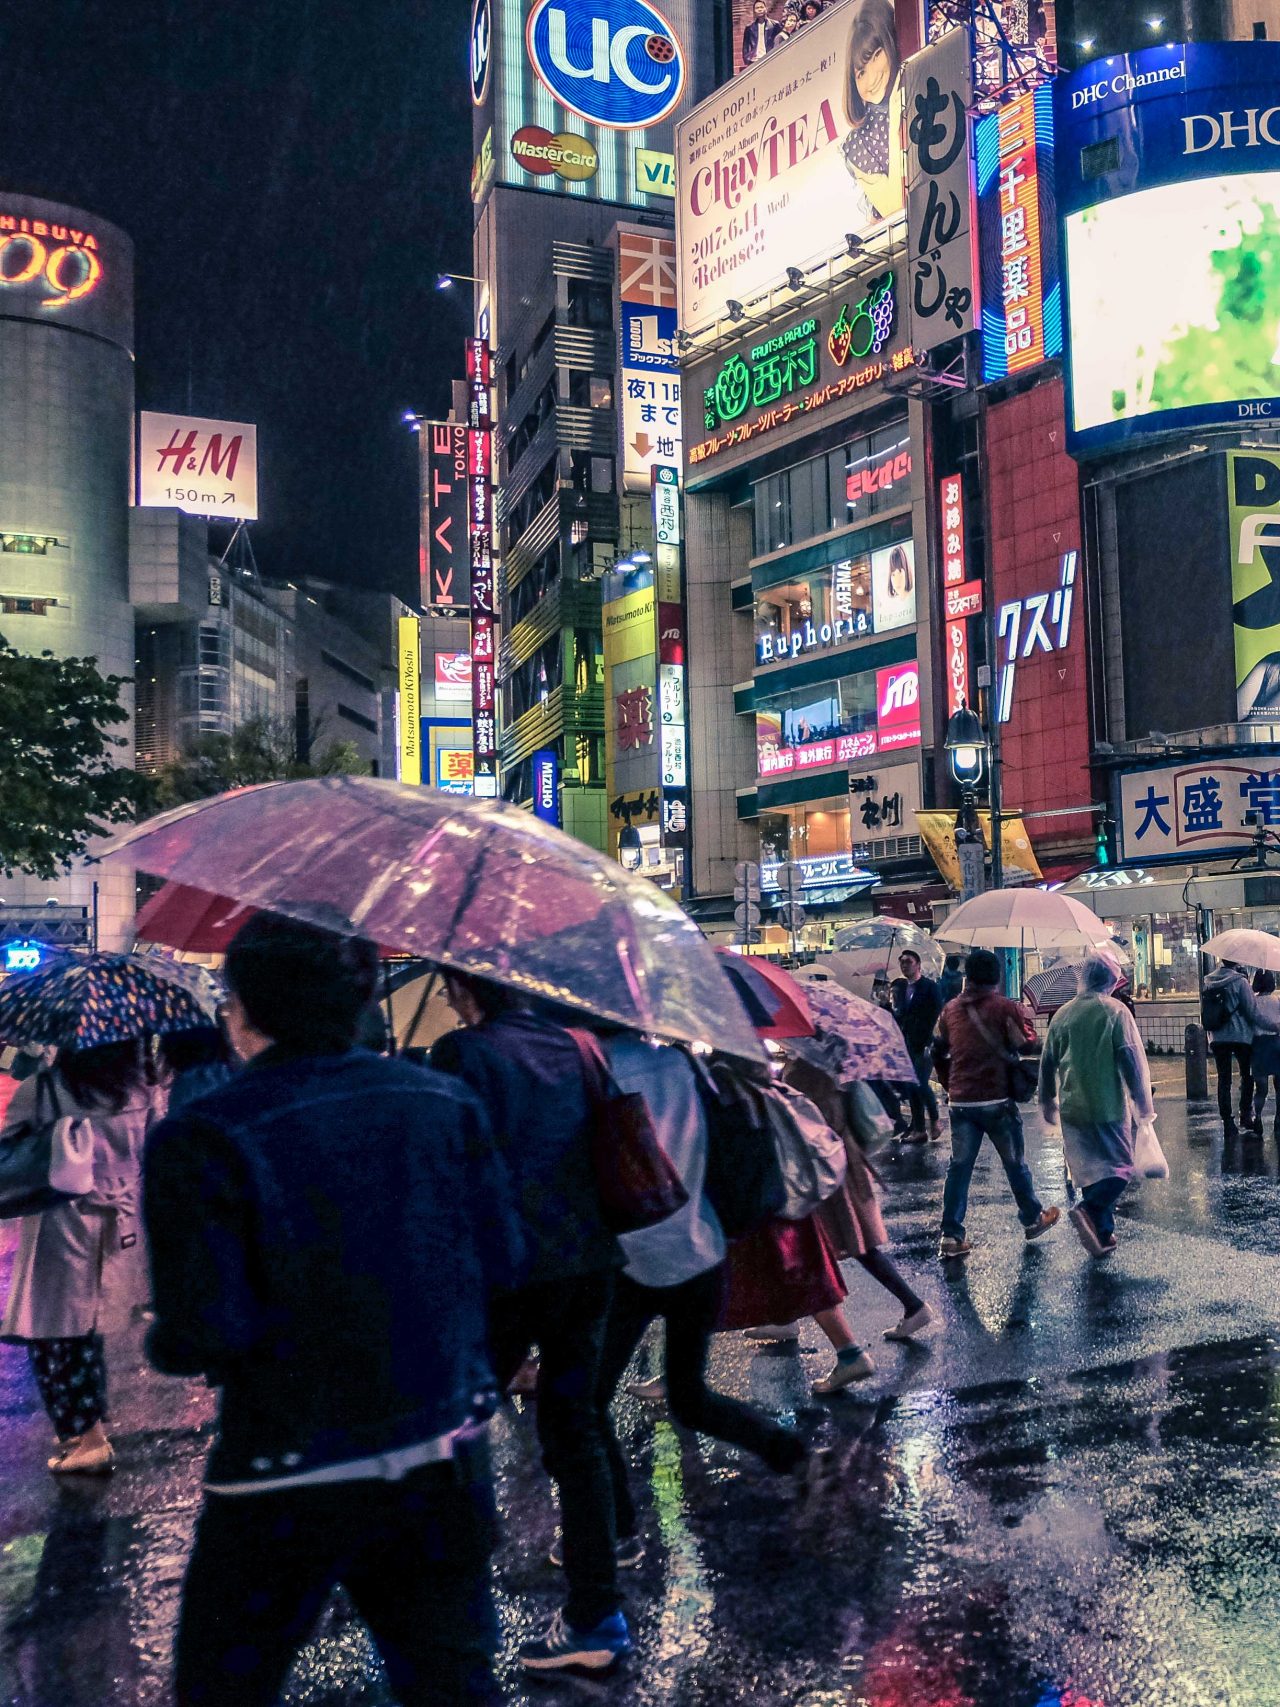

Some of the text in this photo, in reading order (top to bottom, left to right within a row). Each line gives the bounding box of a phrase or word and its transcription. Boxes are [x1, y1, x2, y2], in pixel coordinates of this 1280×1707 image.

[1072, 60, 1187, 110] DHC Channel
[688, 87, 757, 147] SPICY POP!!
[512, 139, 597, 169] MasterCard
[910, 77, 971, 327] もんじゃ
[621, 238, 678, 307] 本
[692, 229, 766, 290] Release!!
[630, 318, 643, 350] BOOK
[753, 338, 817, 408] 西村
[641, 403, 679, 425] まで
[1238, 401, 1273, 418] DHC
[157, 428, 243, 483] H&M
[454, 426, 465, 481] TOKYO
[606, 607, 644, 628] Matsumoto
[761, 613, 868, 660] Euphoria
[404, 649, 415, 758] Matsumoto KiYoshi
[881, 672, 919, 718] JTB
[800, 746, 833, 765] 海外旅行
[840, 734, 874, 750] ハネムーン
[542, 761, 553, 809] MIZUHO
